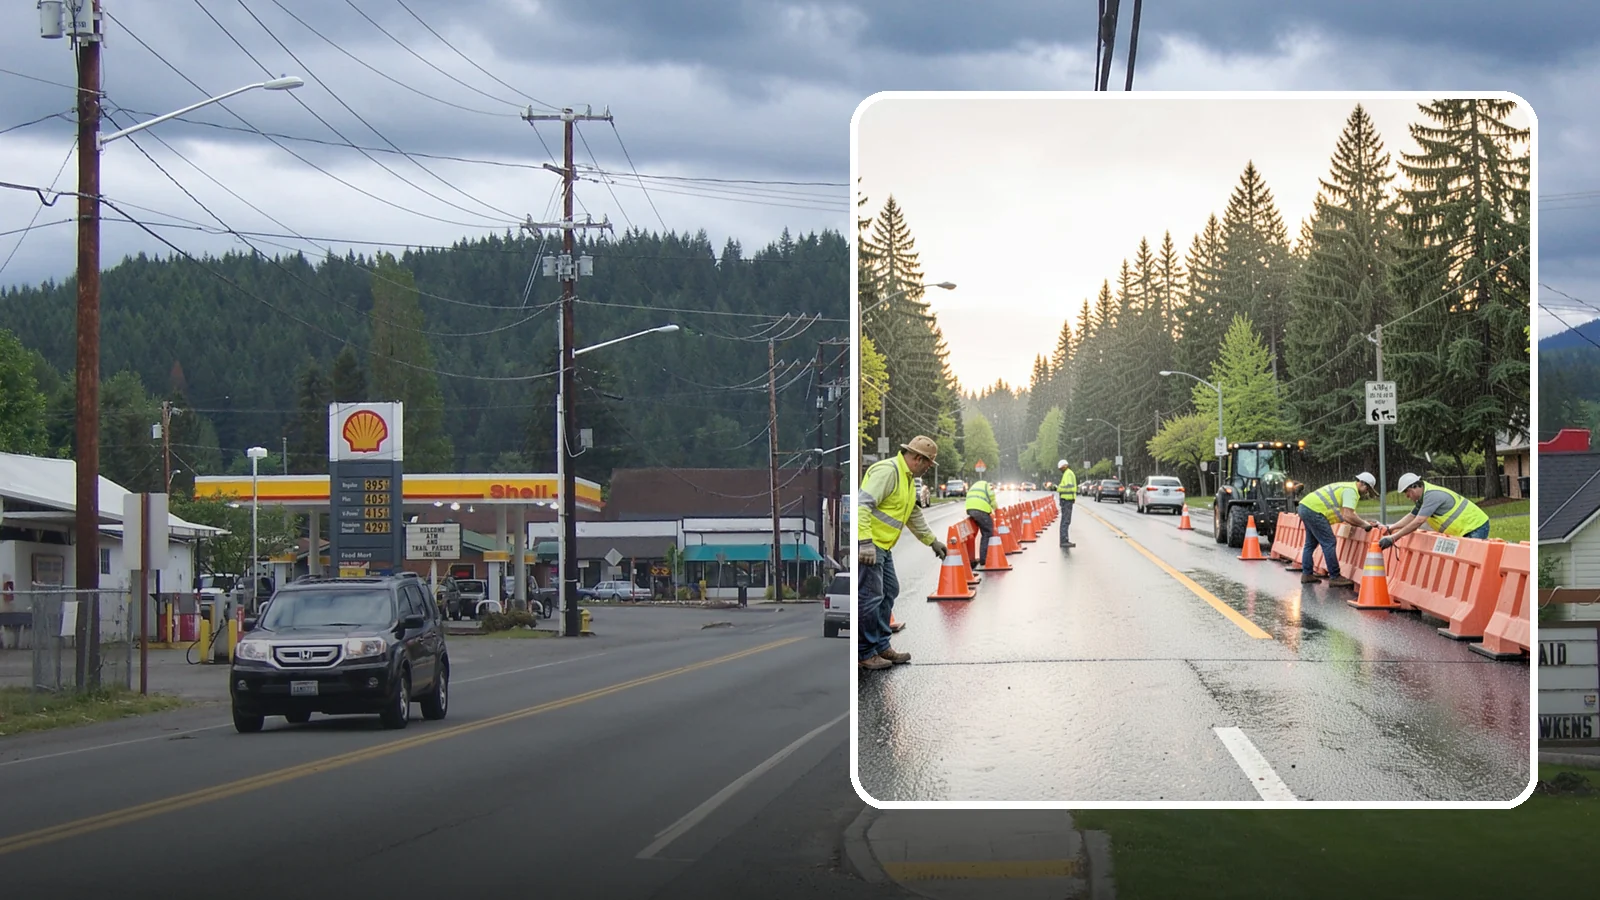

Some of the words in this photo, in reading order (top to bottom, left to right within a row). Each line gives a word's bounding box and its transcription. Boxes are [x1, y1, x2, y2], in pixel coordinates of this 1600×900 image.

[366, 480, 384, 490] 395
[490, 484, 547, 499] Shell
[366, 494, 384, 504] 405
[366, 508, 383, 518] 415
[366, 522, 383, 532] 429
